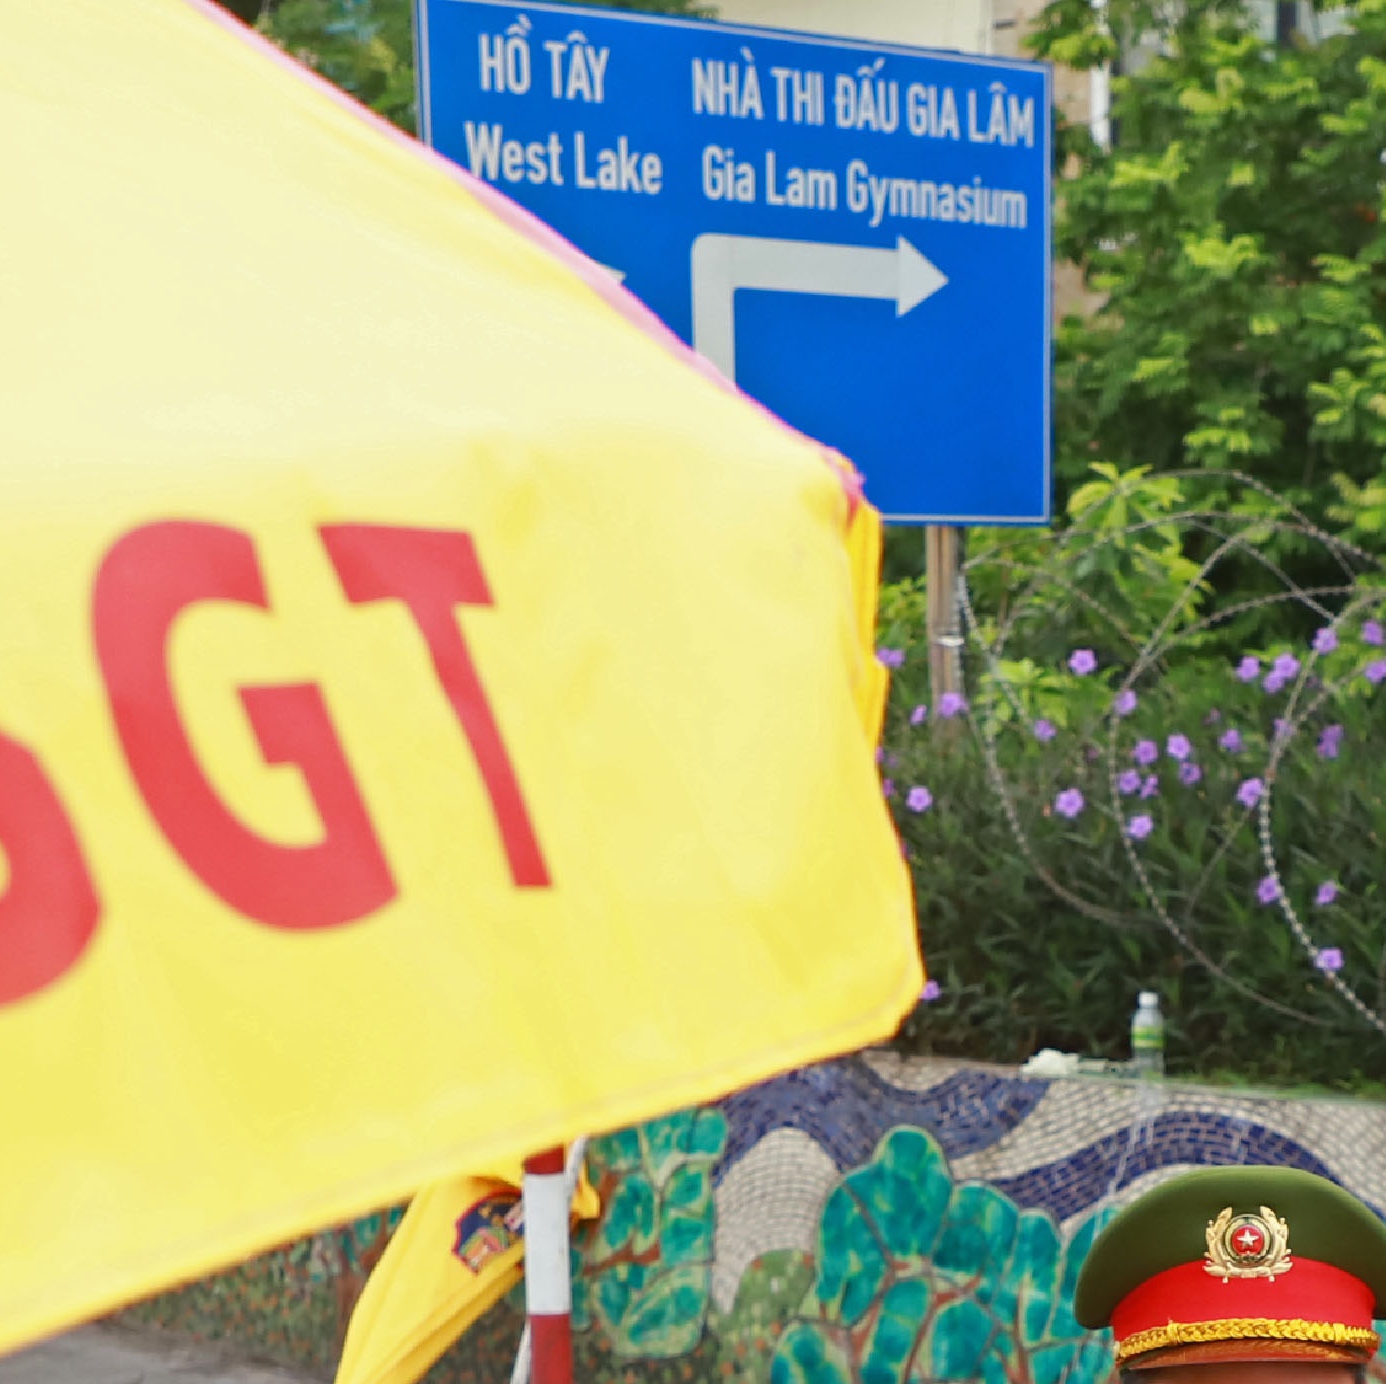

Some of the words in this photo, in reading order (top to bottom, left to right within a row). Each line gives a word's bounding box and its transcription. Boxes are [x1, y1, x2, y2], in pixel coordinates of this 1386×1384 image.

[478, 13, 532, 95] HỒ
[543, 30, 611, 104] TÂY
[691, 46, 764, 120] NHÀ
[771, 67, 825, 126] THI
[833, 57, 899, 134] ĐẤU
[906, 82, 961, 141] GIA
[967, 81, 1035, 148] LÂM
[464, 120, 564, 186] West
[574, 131, 662, 195] Lake
[702, 145, 756, 203] Gia
[766, 149, 837, 211] Lam
[846, 158, 1028, 229] Gymnasium
